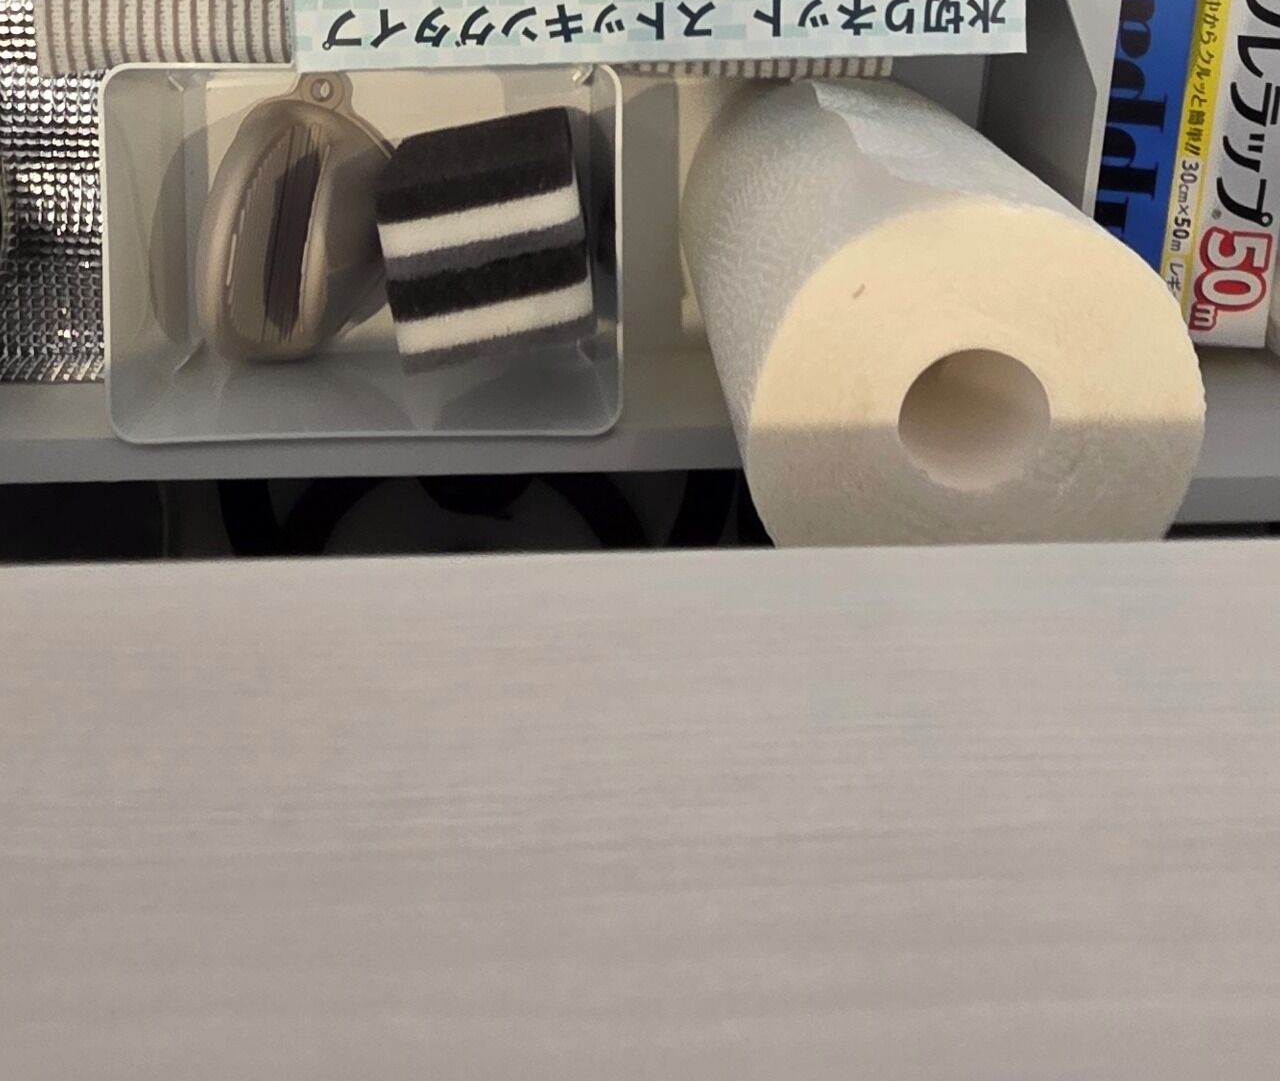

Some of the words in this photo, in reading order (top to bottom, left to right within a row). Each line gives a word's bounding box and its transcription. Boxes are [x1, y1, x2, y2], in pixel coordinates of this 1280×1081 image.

[321, 0, 716, 52] ストッキングタイプ
